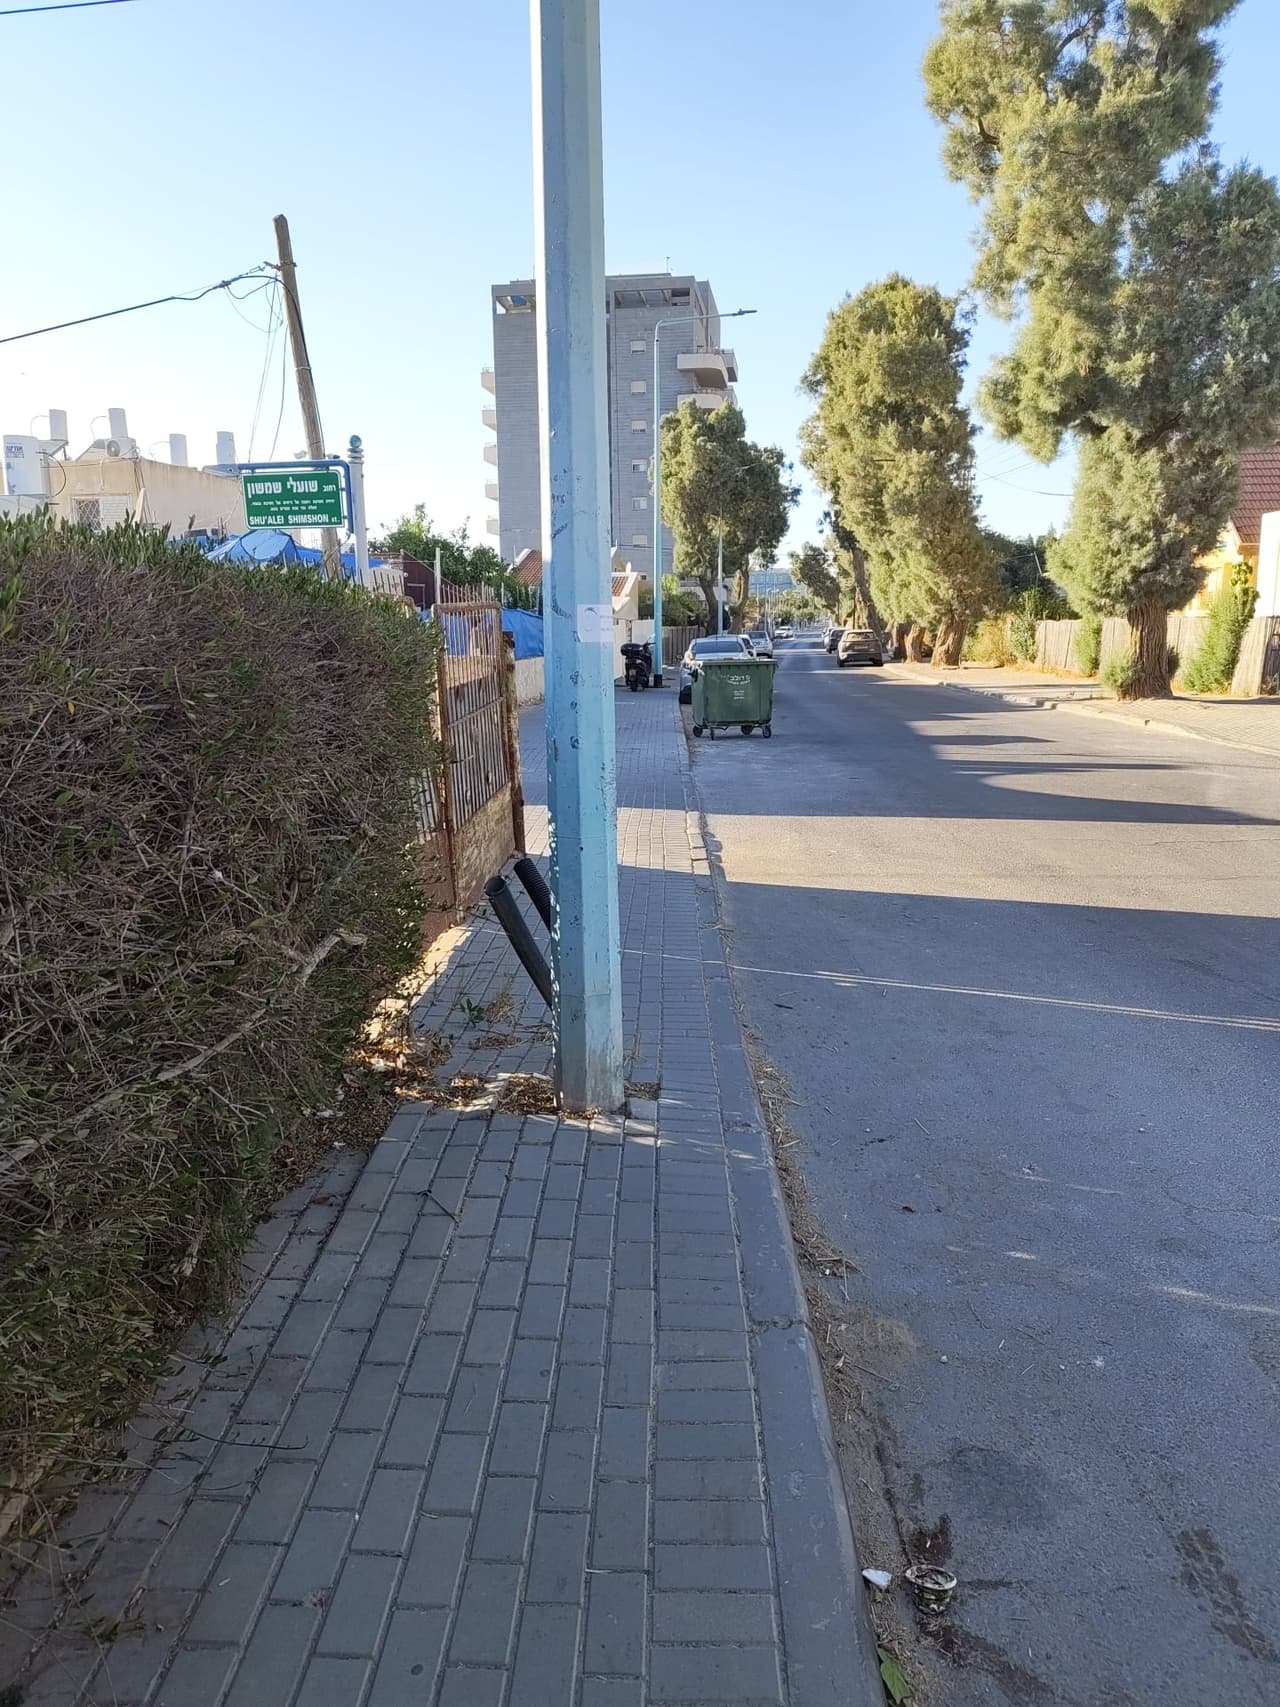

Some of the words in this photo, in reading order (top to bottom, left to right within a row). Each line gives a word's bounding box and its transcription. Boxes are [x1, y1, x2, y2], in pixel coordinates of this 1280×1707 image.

[247, 481, 282, 499] שמשון
[287, 476, 318, 493] שועלי
[322, 484, 336, 492] רחוב
[249, 515, 285, 525] SHU'ALEI
[287, 514, 329, 524] SHIMSHON
